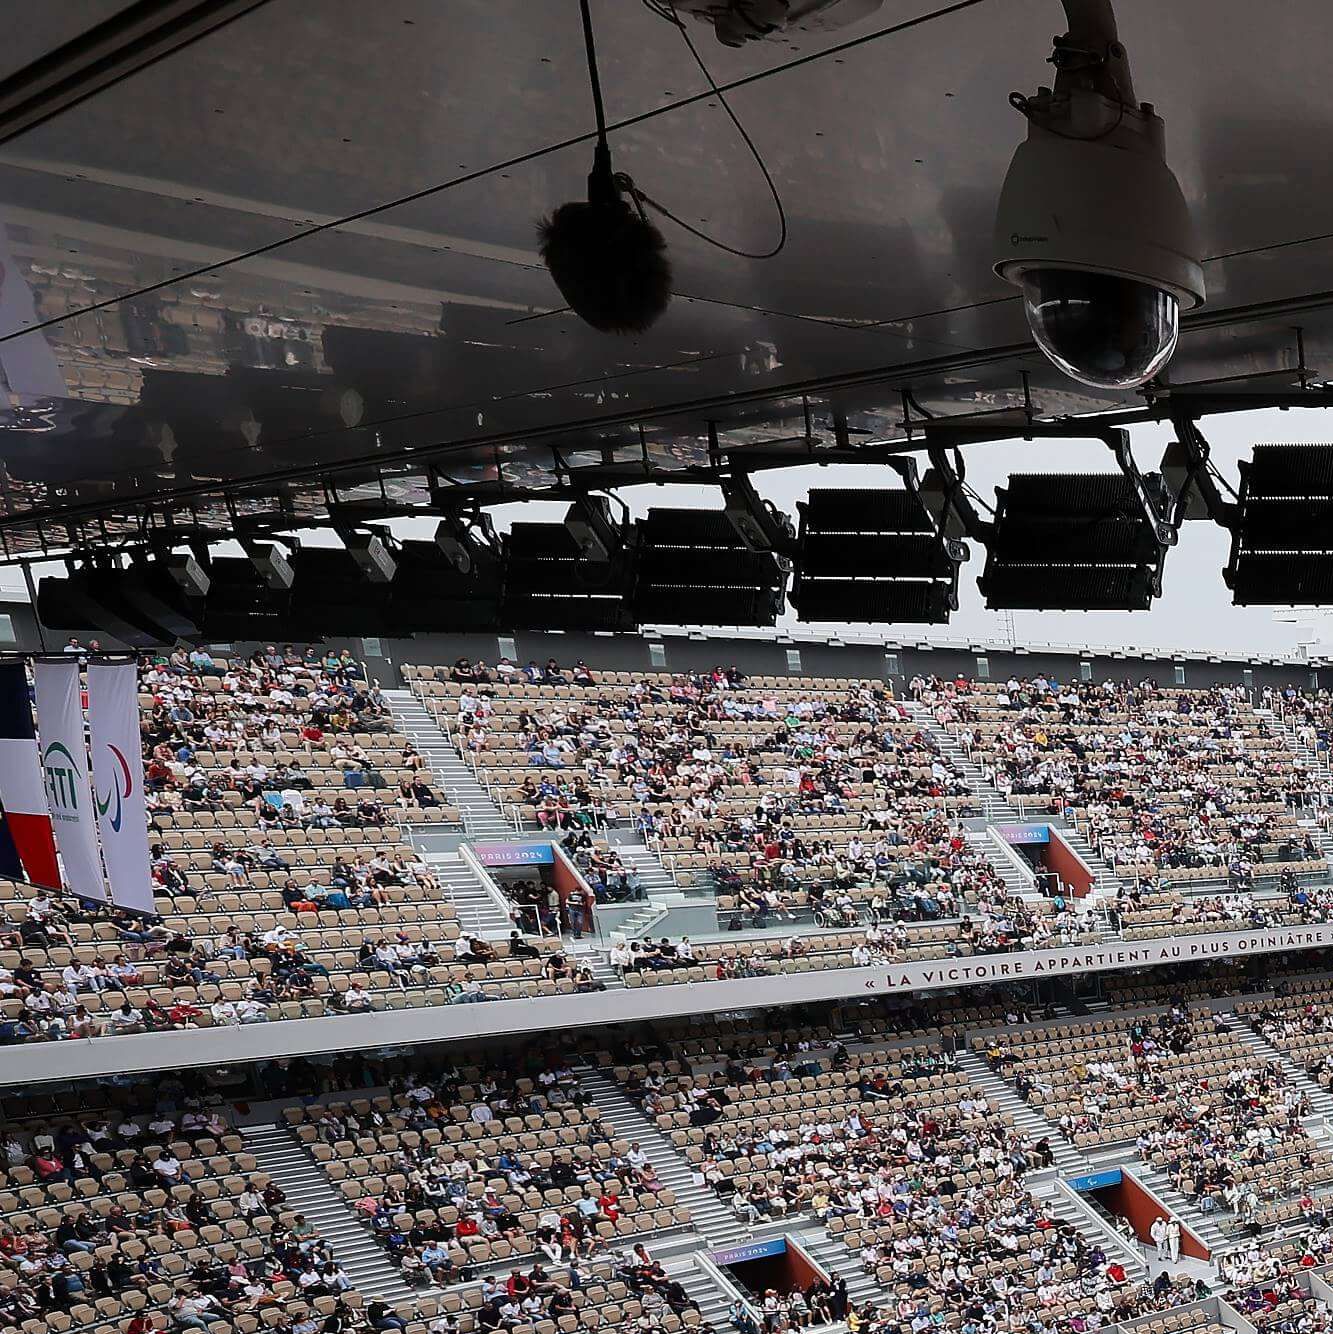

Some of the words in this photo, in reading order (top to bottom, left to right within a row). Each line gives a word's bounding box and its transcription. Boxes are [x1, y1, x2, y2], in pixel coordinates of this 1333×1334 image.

[480, 851, 511, 860] PARIS
[514, 851, 542, 860] 2024
[887, 974, 911, 987] LA
[923, 962, 1023, 983] VICTOIRE
[1034, 950, 1150, 971] APPARTIENT
[1160, 946, 1181, 959] AU
[1191, 941, 1229, 955] PLUS
[1238, 932, 1323, 950] OPINIÂTRE
[724, 1251, 746, 1260] PARIS
[748, 1246, 769, 1256] 2024
